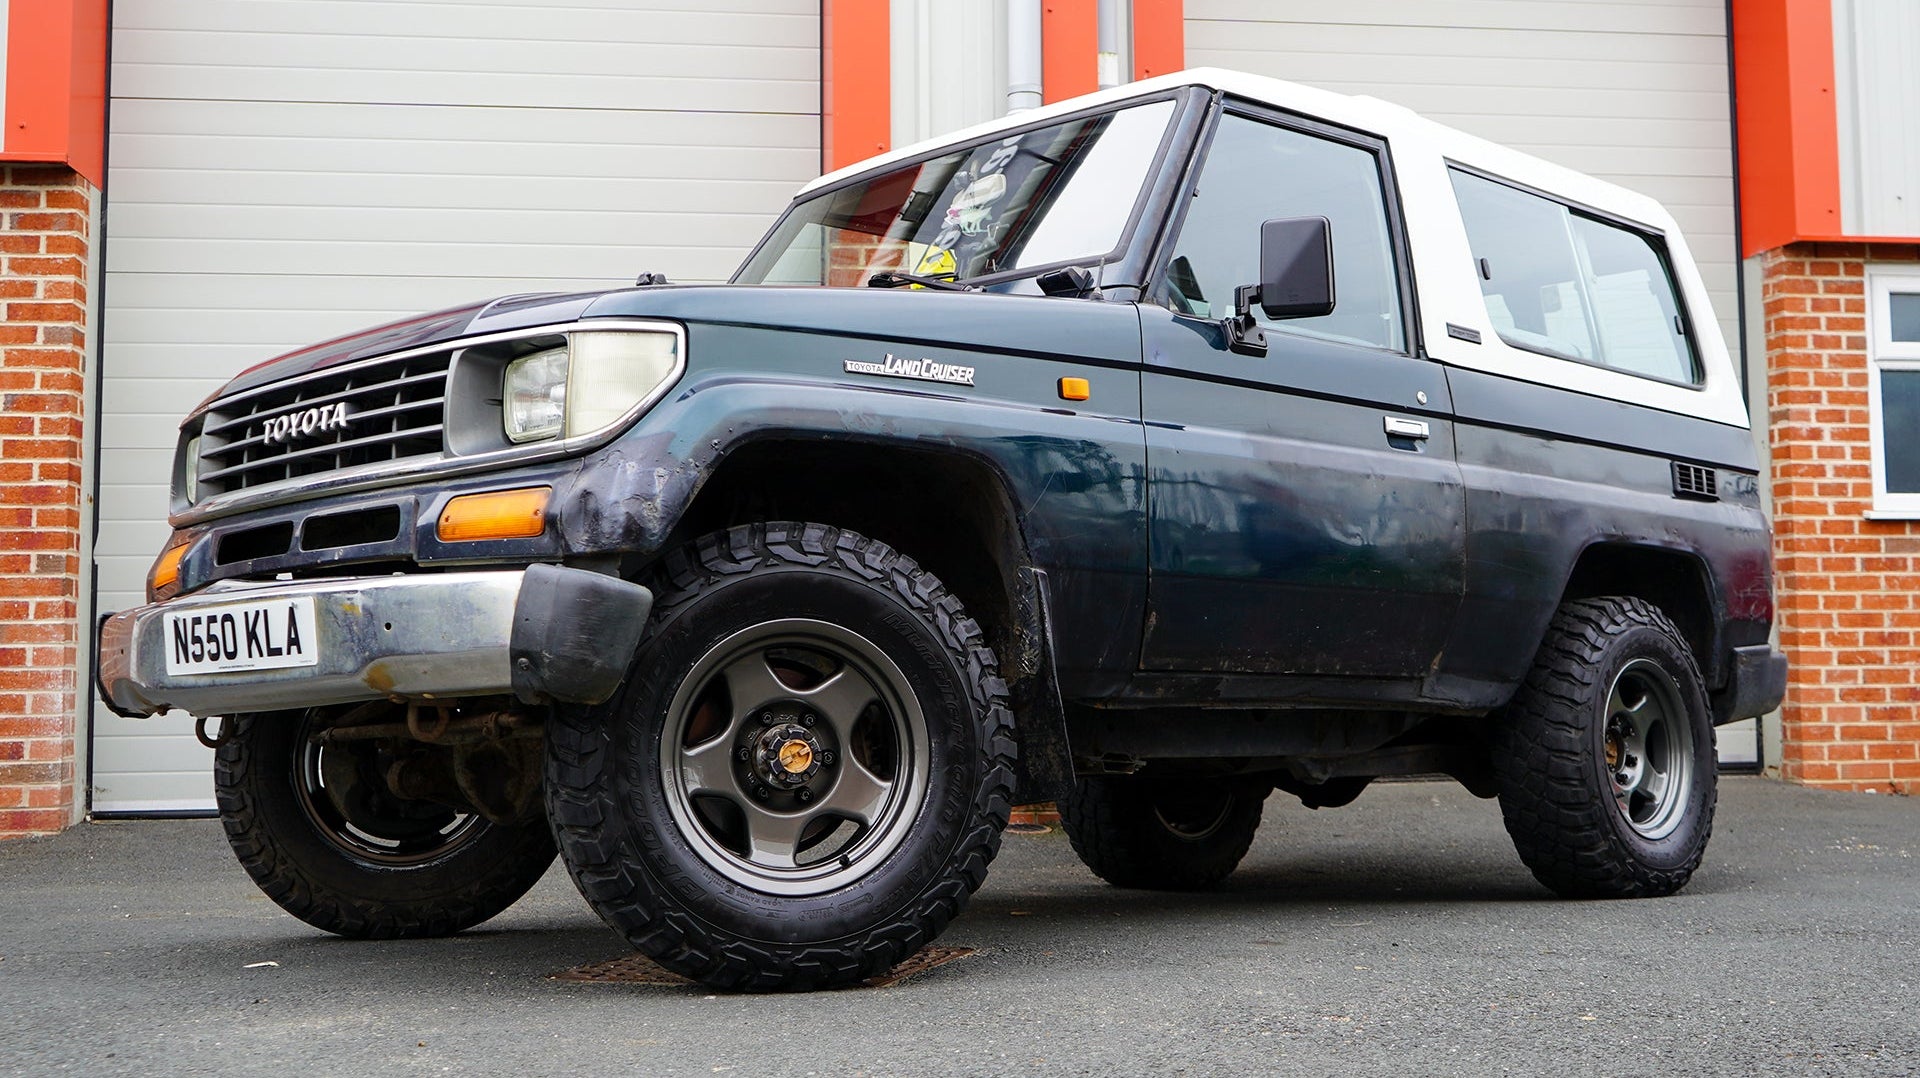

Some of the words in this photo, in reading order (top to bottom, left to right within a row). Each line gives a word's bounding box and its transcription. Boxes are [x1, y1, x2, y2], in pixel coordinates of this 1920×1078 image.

[848, 361, 882, 373] TOYOTA
[263, 402, 347, 444] TOYOTA
[173, 613, 238, 665] N550
[244, 606, 302, 658] KLA
